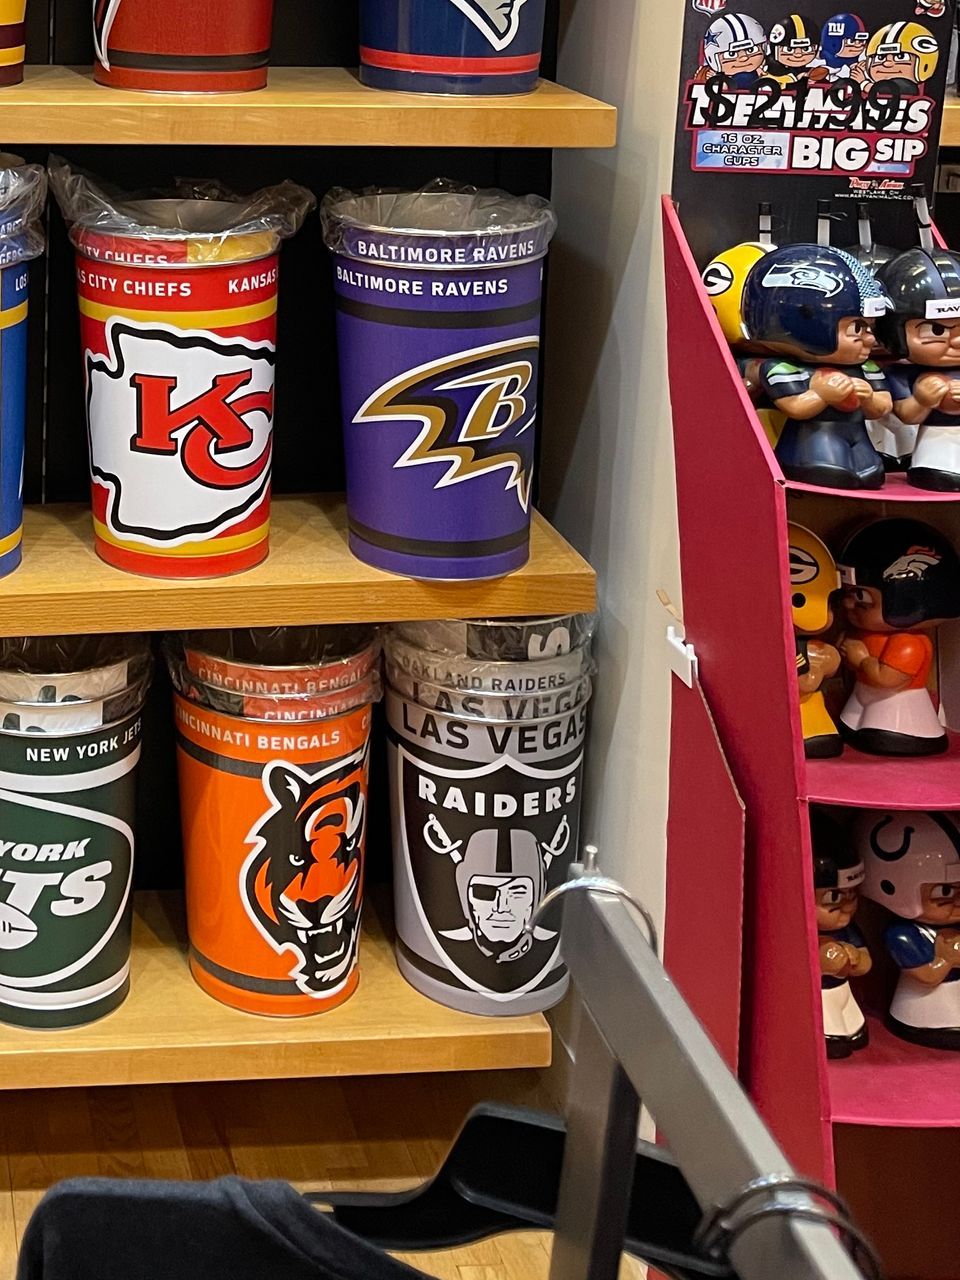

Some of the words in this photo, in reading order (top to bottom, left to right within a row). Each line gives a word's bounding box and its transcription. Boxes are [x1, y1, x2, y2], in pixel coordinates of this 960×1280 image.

[702, 144, 783, 156] CHARACTER
[721, 134, 737, 144] 16
[742, 135, 765, 145] OZ.
[723, 155, 759, 167] CUPS
[792, 136, 870, 171] BIG
[874, 137, 925, 163] SIP
[358, 241, 466, 262] BALTIMORE
[473, 241, 534, 261] RAVENS
[89, 273, 117, 291] CITY
[123, 280, 191, 296] CHIEFS
[228, 269, 276, 293] KANSAS
[337, 267, 423, 294] BALTIMORE
[432, 279, 508, 296] RAVENS
[130, 369, 273, 489] KC
[491, 673, 566, 692] RAIDERS
[257, 730, 341, 750] BENGALS
[402, 703, 470, 750] LAS
[26, 747, 69, 762] NEW
[76, 735, 119, 760] YORK
[418, 774, 577, 818] RAIDERS
